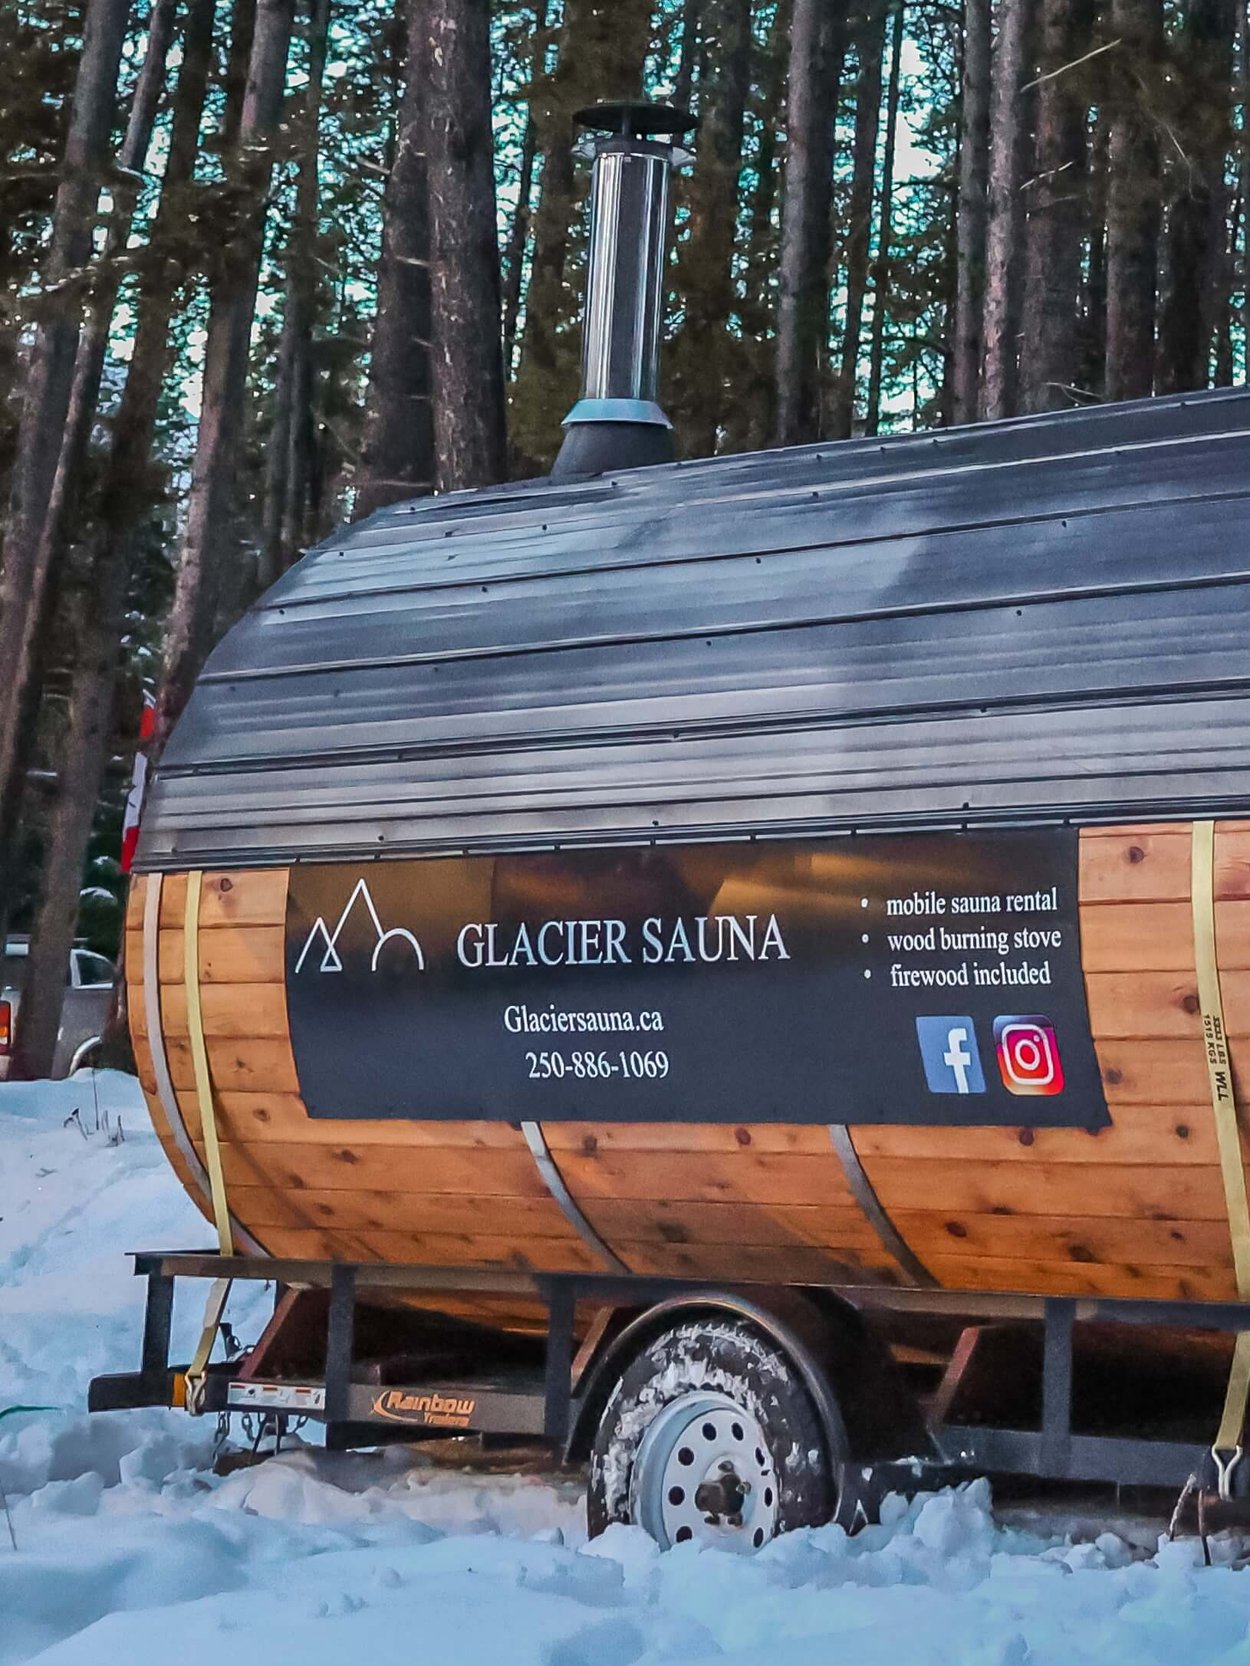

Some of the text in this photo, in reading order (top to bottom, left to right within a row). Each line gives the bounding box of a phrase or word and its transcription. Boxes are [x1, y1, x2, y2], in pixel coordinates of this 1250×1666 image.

[886, 886, 1059, 917] mobile sauna rental
[456, 912, 791, 967] GLACIER SAUNA
[887, 924, 1063, 955] wood burning stove
[889, 960, 1052, 987] firewood included
[503, 1003, 665, 1033] Glaciersauna.ca
[525, 1050, 669, 1080] 250-886-1069
[1207, 1041, 1217, 1065] KGS
[1216, 1043, 1227, 1065] LBS
[1214, 1071, 1230, 1102] WLL
[386, 1390, 476, 1415] Rainbow
